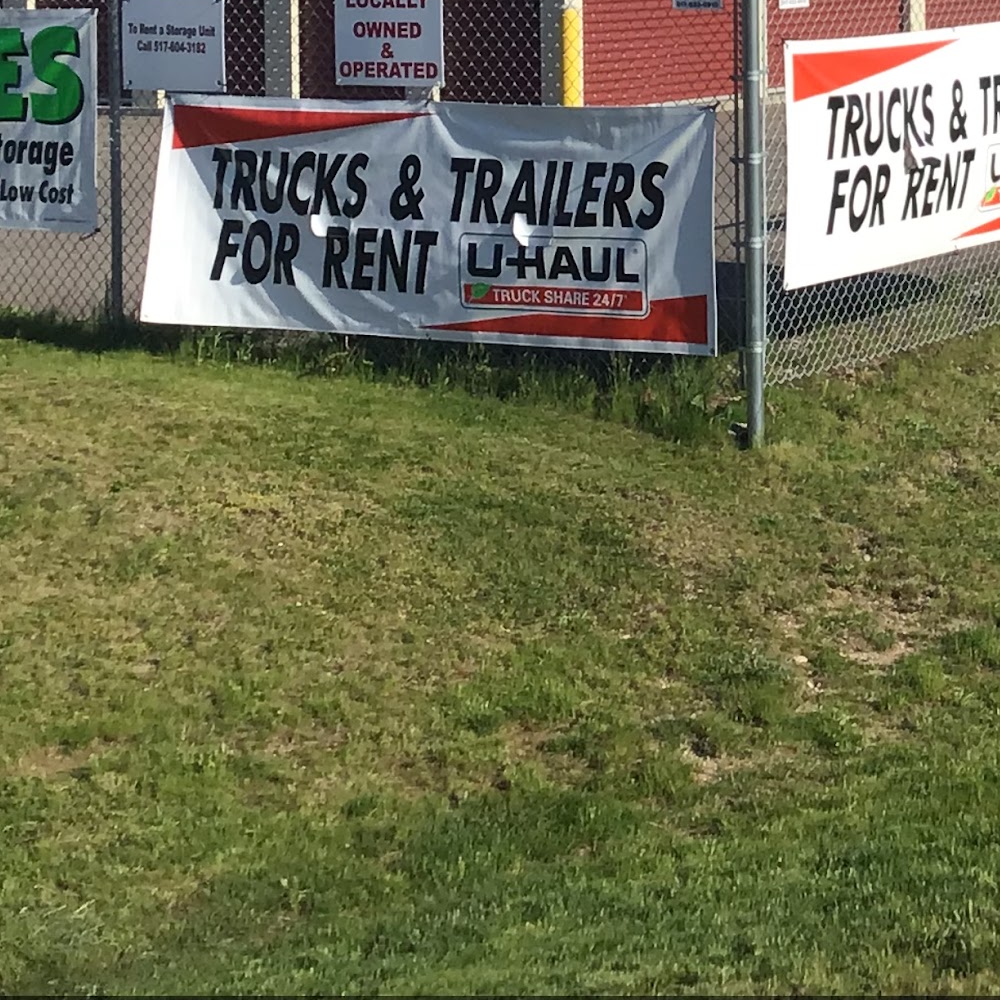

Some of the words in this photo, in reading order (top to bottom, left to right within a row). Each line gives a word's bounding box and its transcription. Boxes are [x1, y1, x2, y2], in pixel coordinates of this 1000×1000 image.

[128, 23, 138, 34] To
[139, 23, 157, 35] Rent
[159, 26, 164, 35] a
[166, 24, 196, 38] Storage
[198, 25, 215, 37] Unit
[353, 21, 422, 38] OWNED
[137, 40, 152, 52] Call
[381, 42, 394, 58] &
[340, 61, 438, 79] OPERATED
[826, 83, 935, 161] TRUCKS
[949, 79, 968, 142] &
[0, 134, 75, 176] orage
[0, 179, 34, 203] Low
[38, 179, 75, 204] Cost
[211, 148, 369, 218] TRUCKS
[389, 154, 425, 221] &
[449, 157, 669, 230] TRAILERS
[826, 163, 891, 235] FOR
[901, 148, 976, 221] RENT
[210, 219, 301, 285] FOR
[322, 227, 439, 294] RENT
[492, 288, 541, 304] TRUCK
[544, 290, 590, 306] SHARE
[593, 293, 624, 308] 24/7
